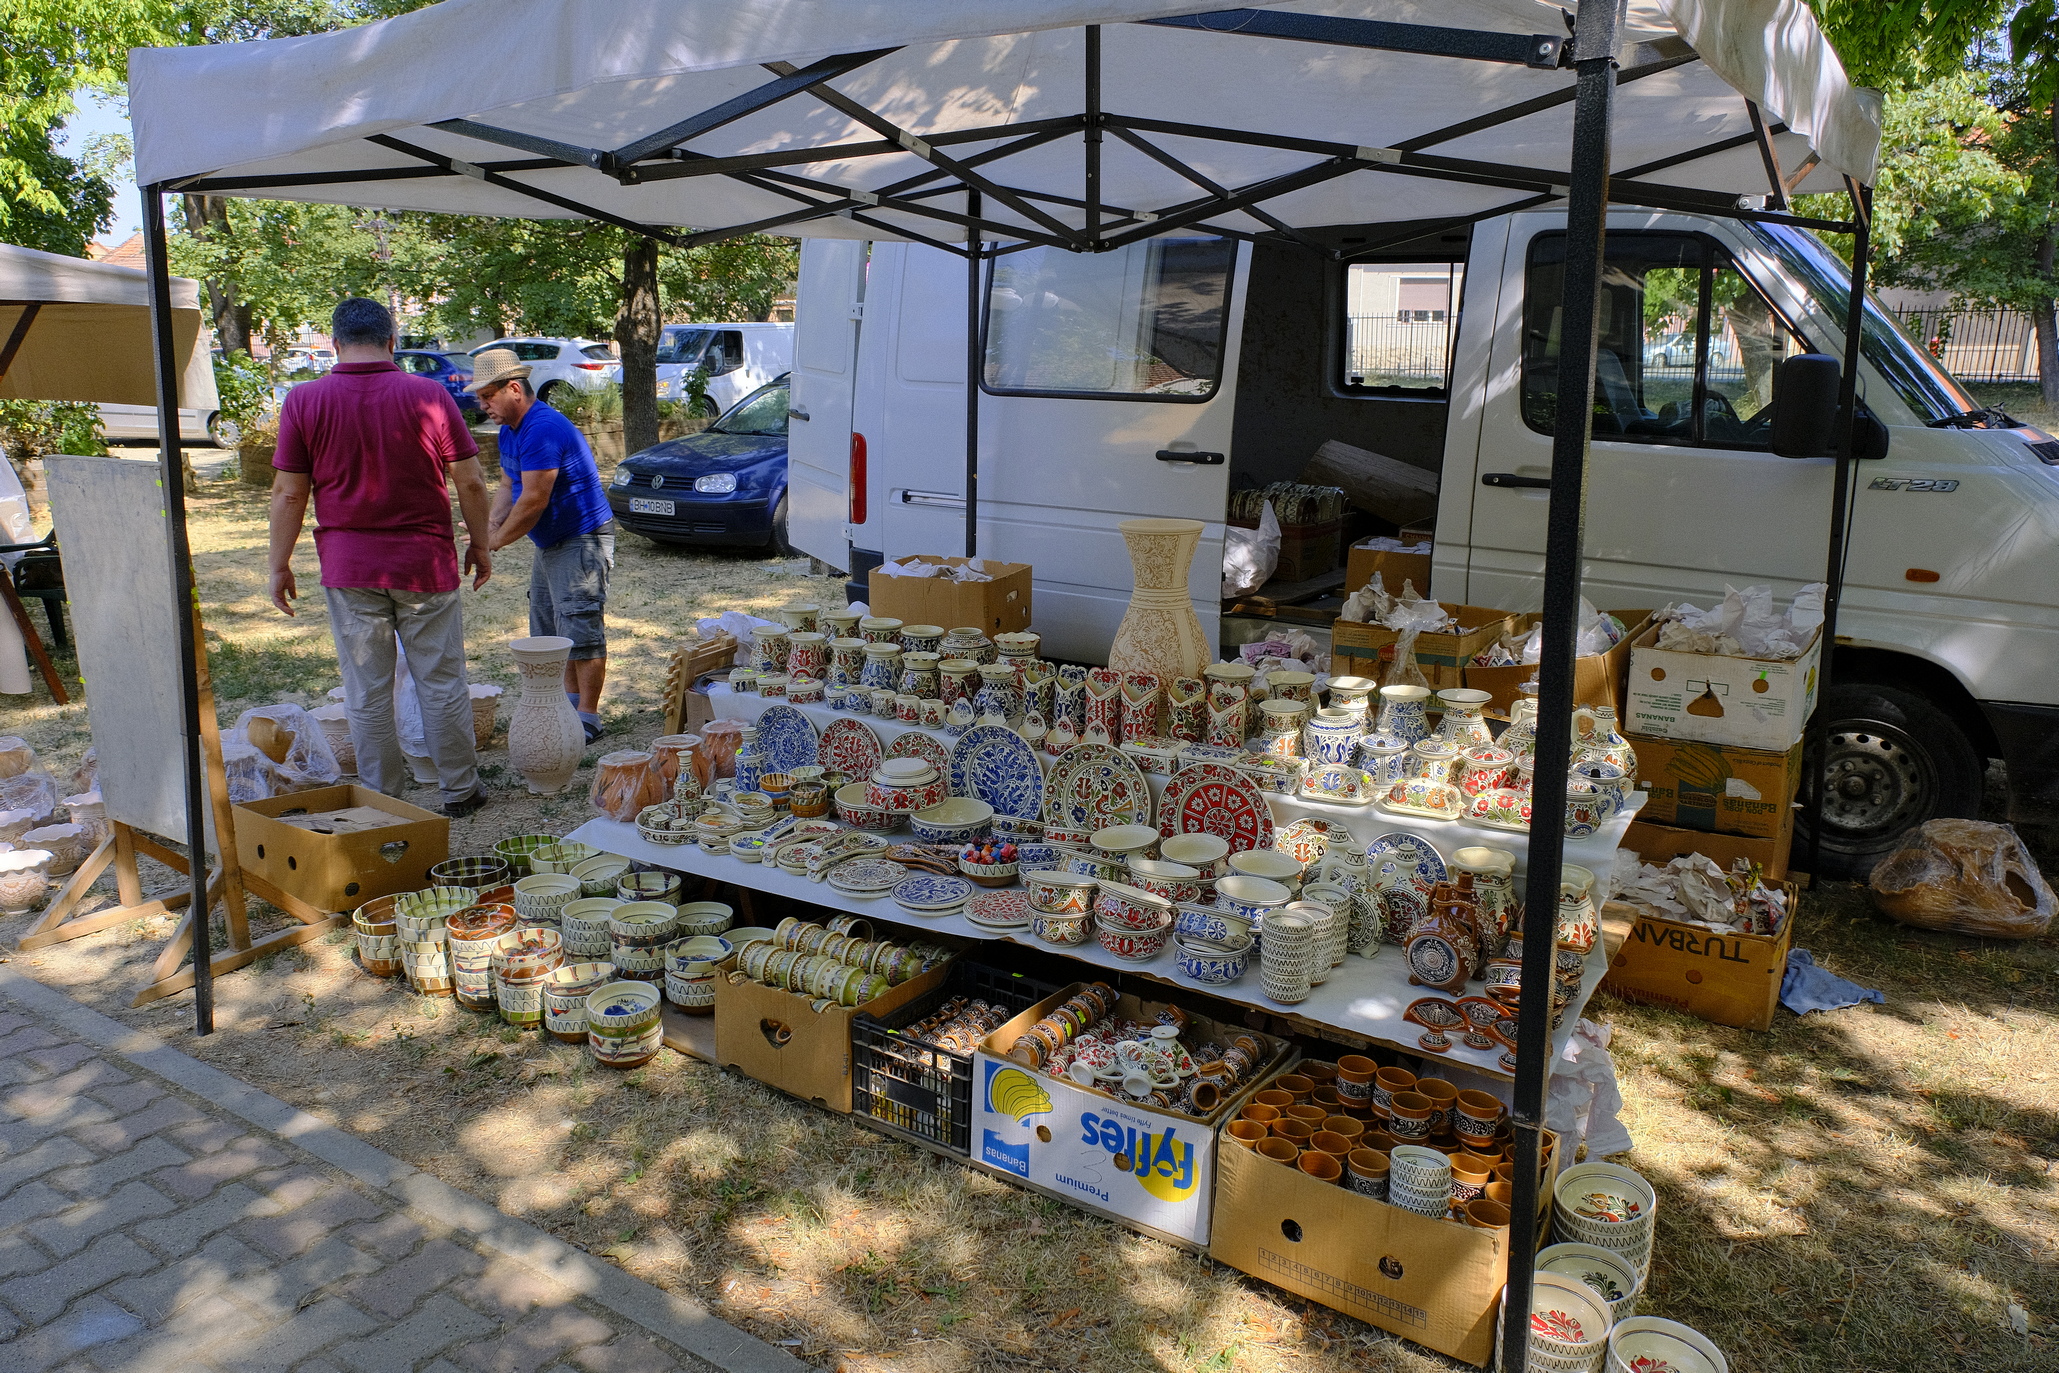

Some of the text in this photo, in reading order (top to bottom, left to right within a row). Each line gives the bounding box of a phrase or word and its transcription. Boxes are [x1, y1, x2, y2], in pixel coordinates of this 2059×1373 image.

[1635, 712, 1676, 723] BANANAS
[1723, 799, 1777, 814] Bananas
[1101, 1107, 1119, 1117] better
[985, 1146, 1027, 1173] Bananas
[1055, 1173, 1109, 1202] Premium
[1293, 1263, 1299, 1271] 4
[1356, 1288, 1366, 1297] 10
[1367, 1292, 1377, 1301] 11
[1379, 1296, 1390, 1306] 12
[1390, 1301, 1401, 1310] 13
[1402, 1306, 1413, 1315] 14
[1415, 1309, 1425, 1319] 15
